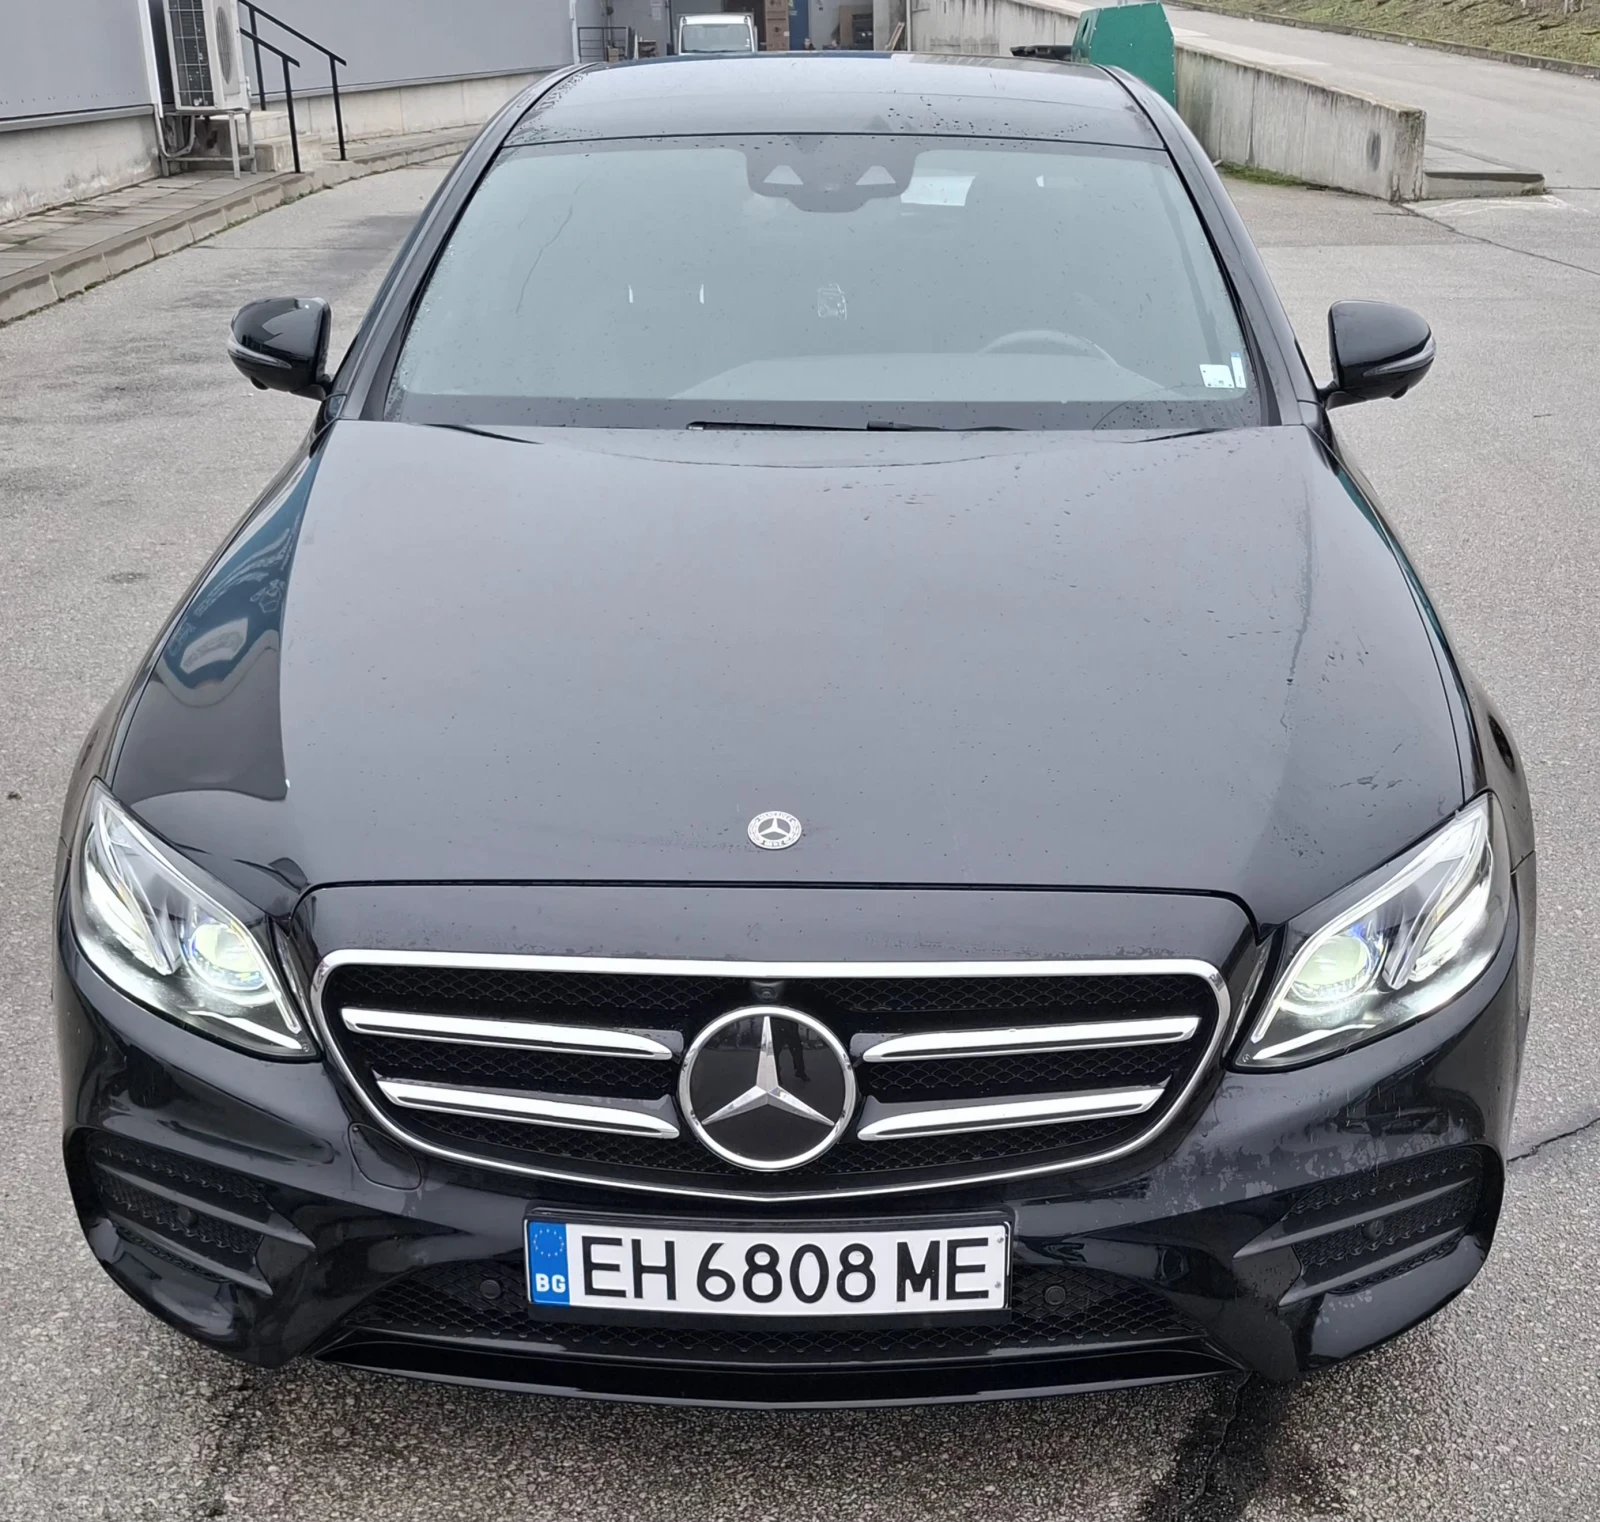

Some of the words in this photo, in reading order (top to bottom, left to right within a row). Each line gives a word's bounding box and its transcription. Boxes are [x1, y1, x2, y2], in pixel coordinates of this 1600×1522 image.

[535, 1273, 566, 1293] BG
[581, 1235, 677, 1301] EH
[697, 1242, 876, 1304] 6808
[896, 1237, 990, 1302] ME
